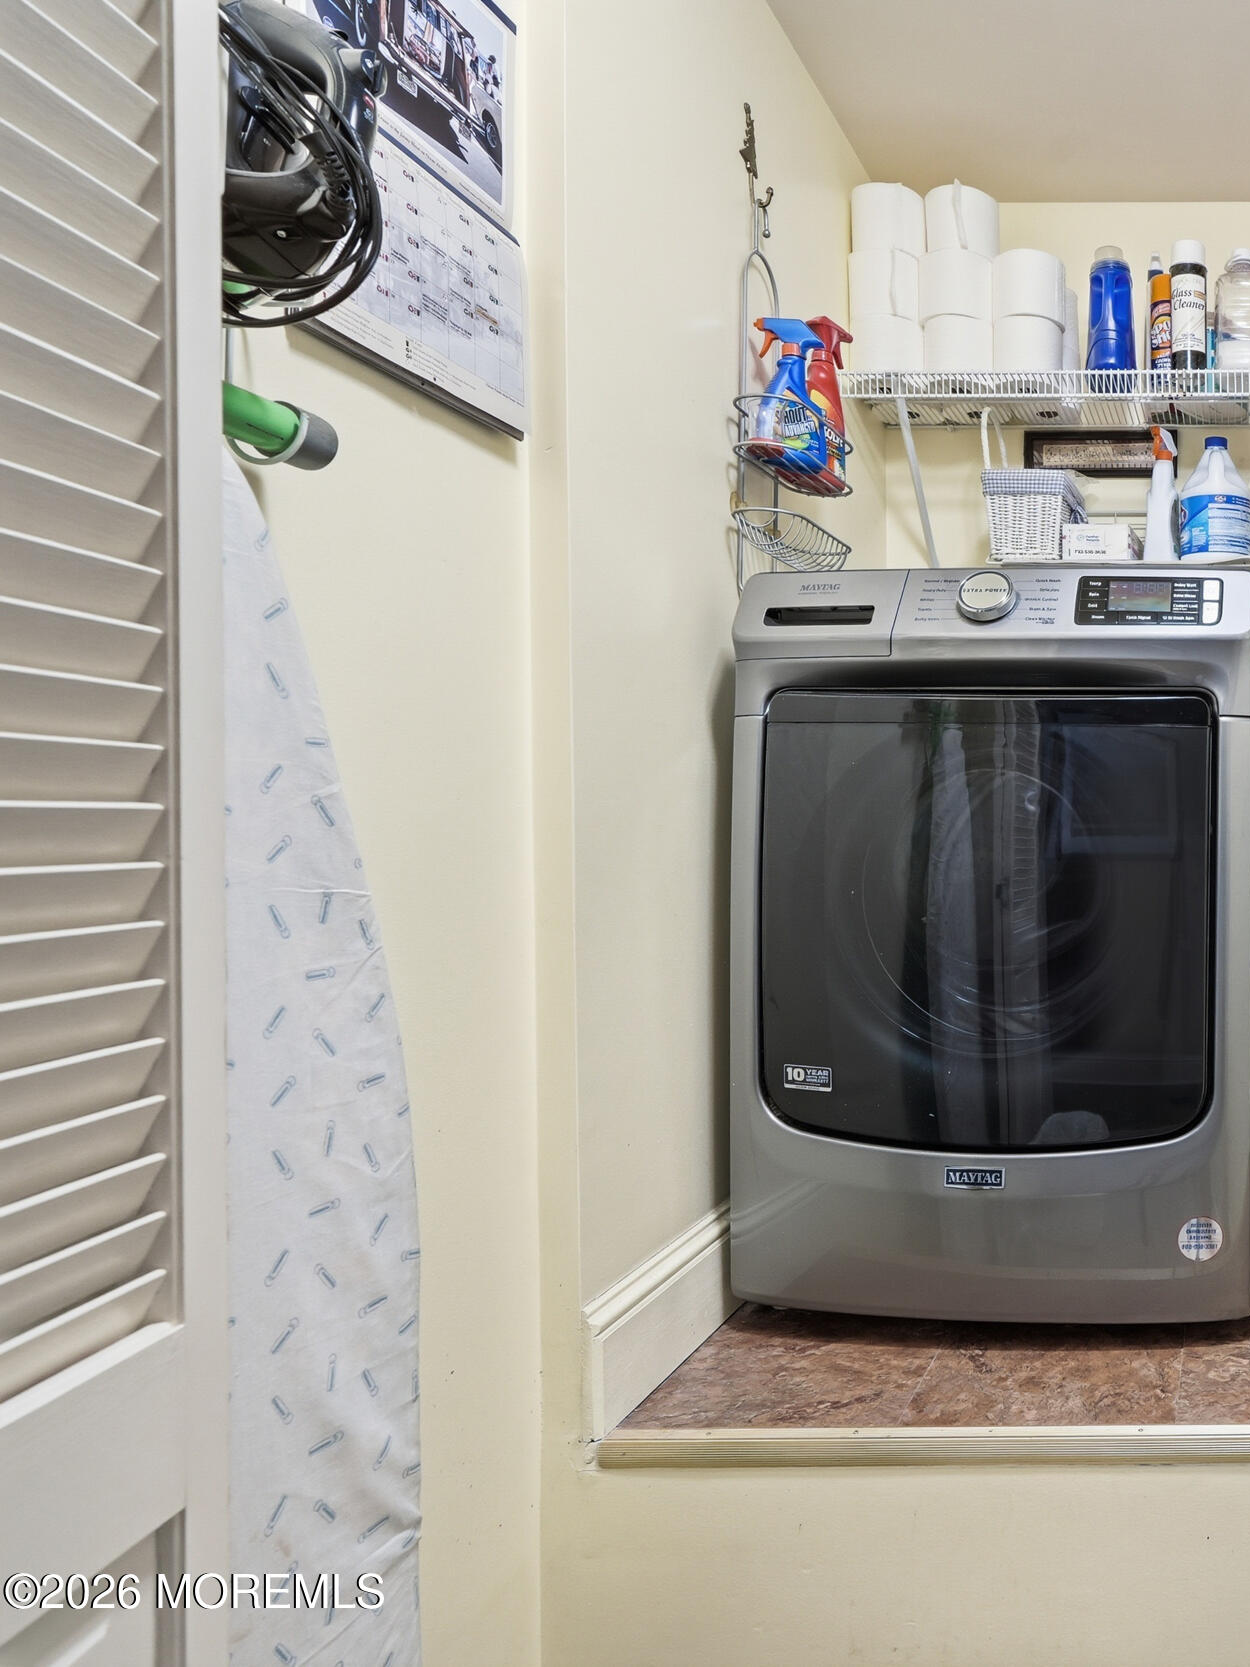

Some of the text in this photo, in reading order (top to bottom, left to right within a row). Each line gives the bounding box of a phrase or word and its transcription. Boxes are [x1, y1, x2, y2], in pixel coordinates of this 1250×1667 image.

[1172, 288, 1193, 299] Glass
[1173, 299, 1205, 311] Cleaner
[800, 583, 841, 592] MAYTAG
[786, 1067, 805, 1081] 10
[806, 1068, 829, 1076] YEAR
[948, 1172, 1001, 1184] MAYTAG
